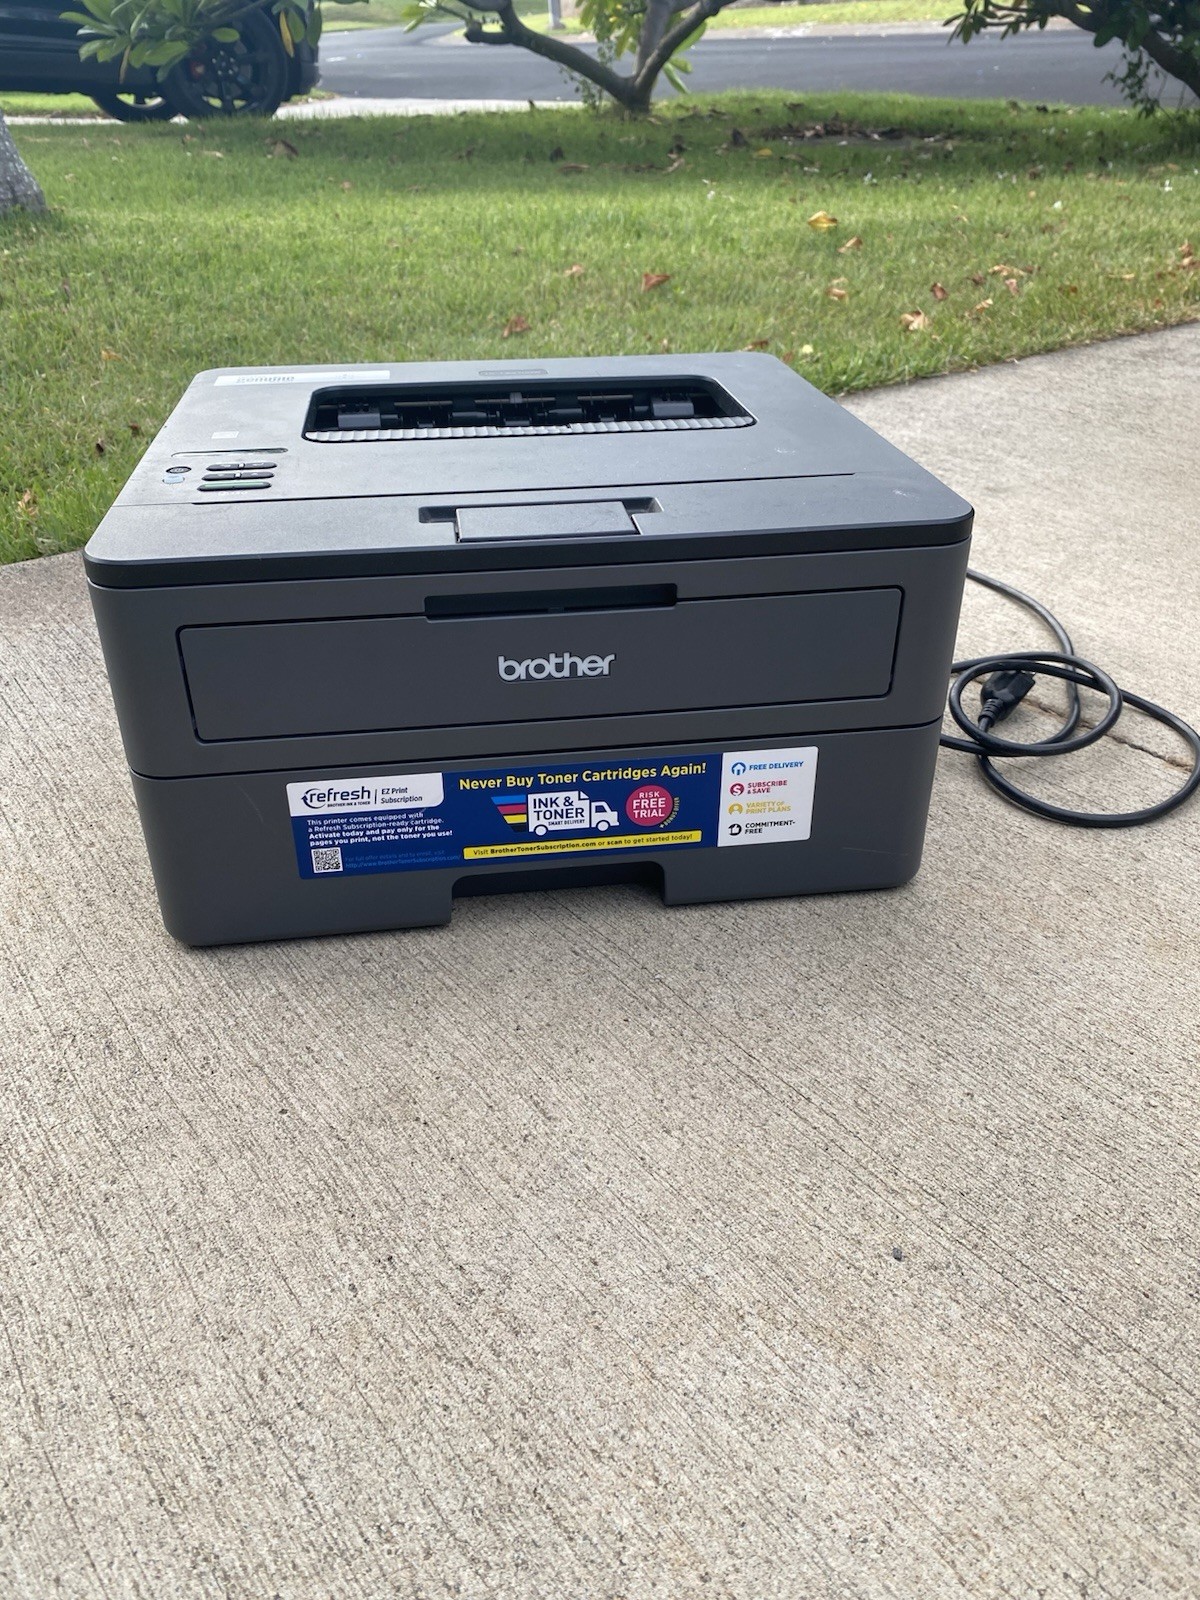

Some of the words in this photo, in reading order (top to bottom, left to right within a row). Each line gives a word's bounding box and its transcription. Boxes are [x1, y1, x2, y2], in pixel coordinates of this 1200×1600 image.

[498, 652, 615, 681] brother
[768, 761, 804, 770] DELIVERY
[460, 778, 502, 790] Never
[506, 776, 534, 788] Buy
[538, 773, 578, 785] Toner
[582, 768, 656, 782] Cartridges
[661, 763, 706, 778] Again!
[748, 780, 788, 788] SUBSCRIBE
[310, 786, 370, 803] refresh
[381, 796, 422, 804] Subscription
[533, 796, 560, 809] INK
[563, 796, 574, 806] &
[632, 798, 666, 809] FREE
[374, 813, 406, 821] equipped
[534, 808, 584, 821] TONER
[633, 809, 665, 818] TRIAL
[343, 820, 408, 830] Subscription-ready
[745, 820, 796, 828] COMMITMENT-
[350, 836, 370, 844] print,
[490, 842, 596, 854] BrotherTonerSubscription.com
